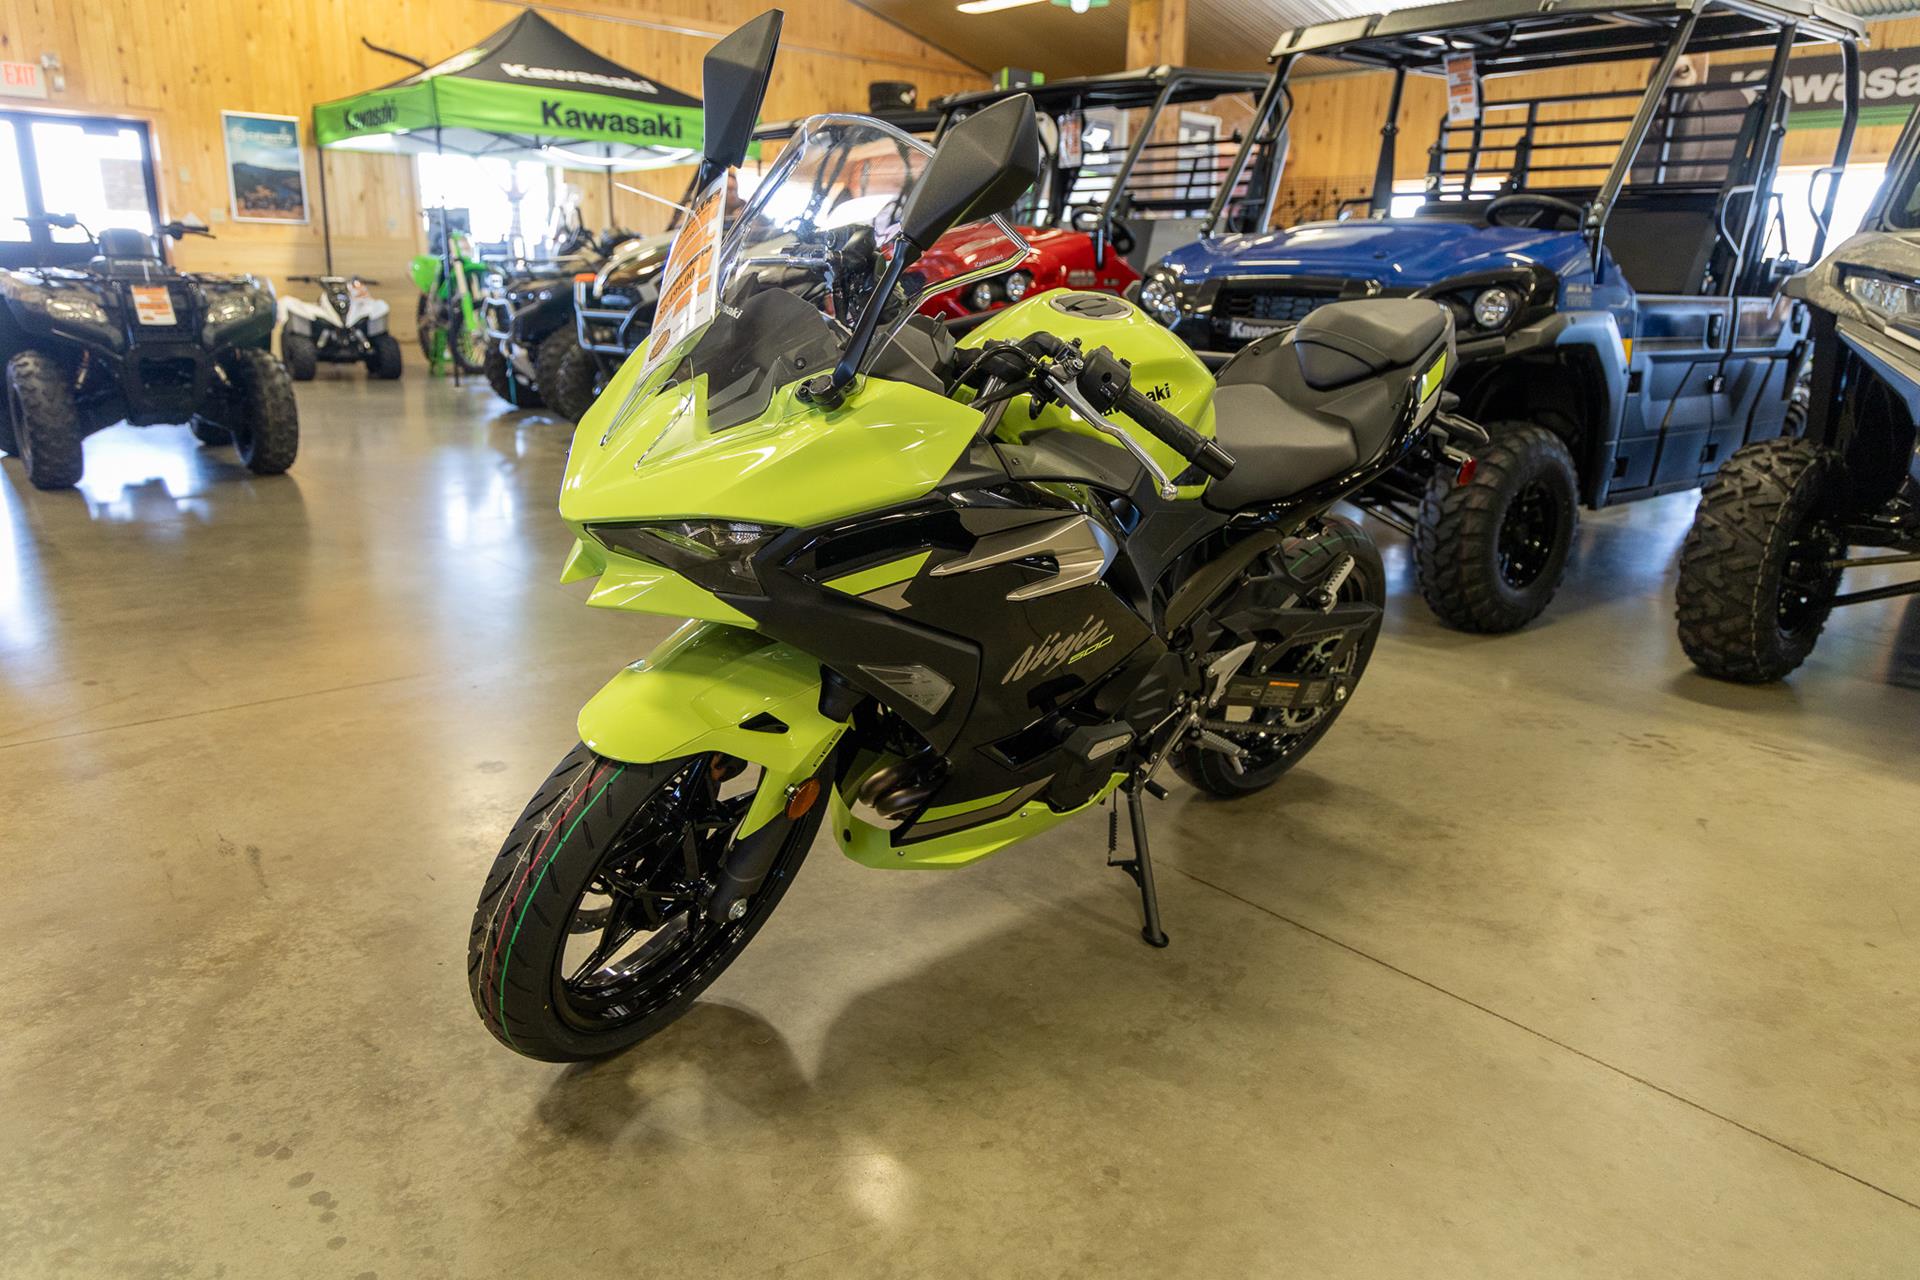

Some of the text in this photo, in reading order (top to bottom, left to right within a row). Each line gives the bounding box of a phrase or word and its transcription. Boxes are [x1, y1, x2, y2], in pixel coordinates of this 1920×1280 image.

[3, 63, 37, 86] EXIT
[500, 63, 658, 95] Kawasaki
[541, 100, 682, 139] Kawasaki
[1001, 614, 1115, 685] Ninja 500
